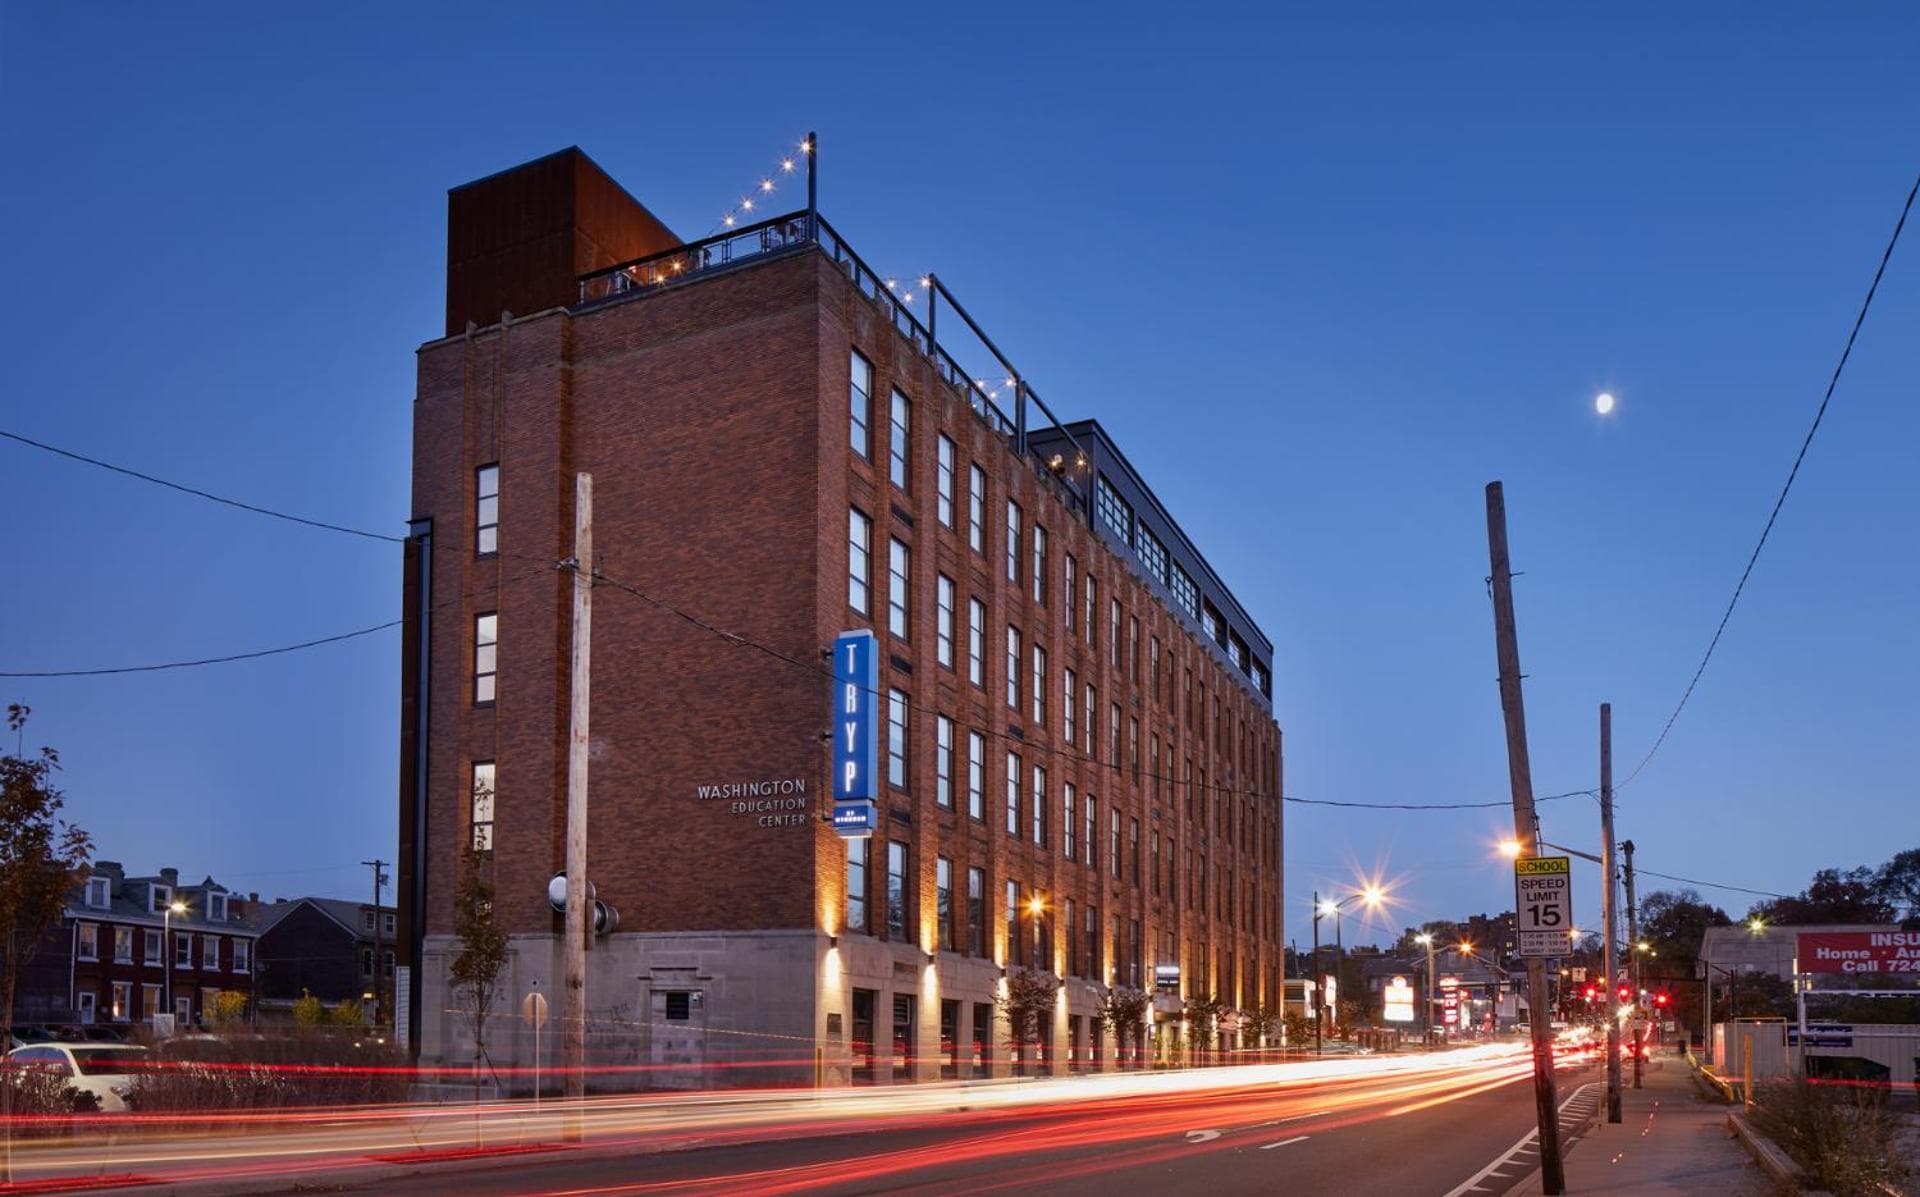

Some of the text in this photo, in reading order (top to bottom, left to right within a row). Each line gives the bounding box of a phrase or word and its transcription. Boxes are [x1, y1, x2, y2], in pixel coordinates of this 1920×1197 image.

[845, 644, 857, 793] TRYP
[698, 779, 805, 800] WASHINGTON
[731, 798, 805, 814] EDUCATION
[759, 814, 805, 828] CENTER
[1519, 861, 1566, 872] SCHOOL
[1521, 879, 1565, 889] SPEED
[1526, 891, 1561, 902] LIMIT
[1527, 904, 1561, 926] 15
[1871, 933, 1920, 946] INSU
[1816, 946, 1920, 959] Home Au
[1842, 960, 1878, 972] Call
